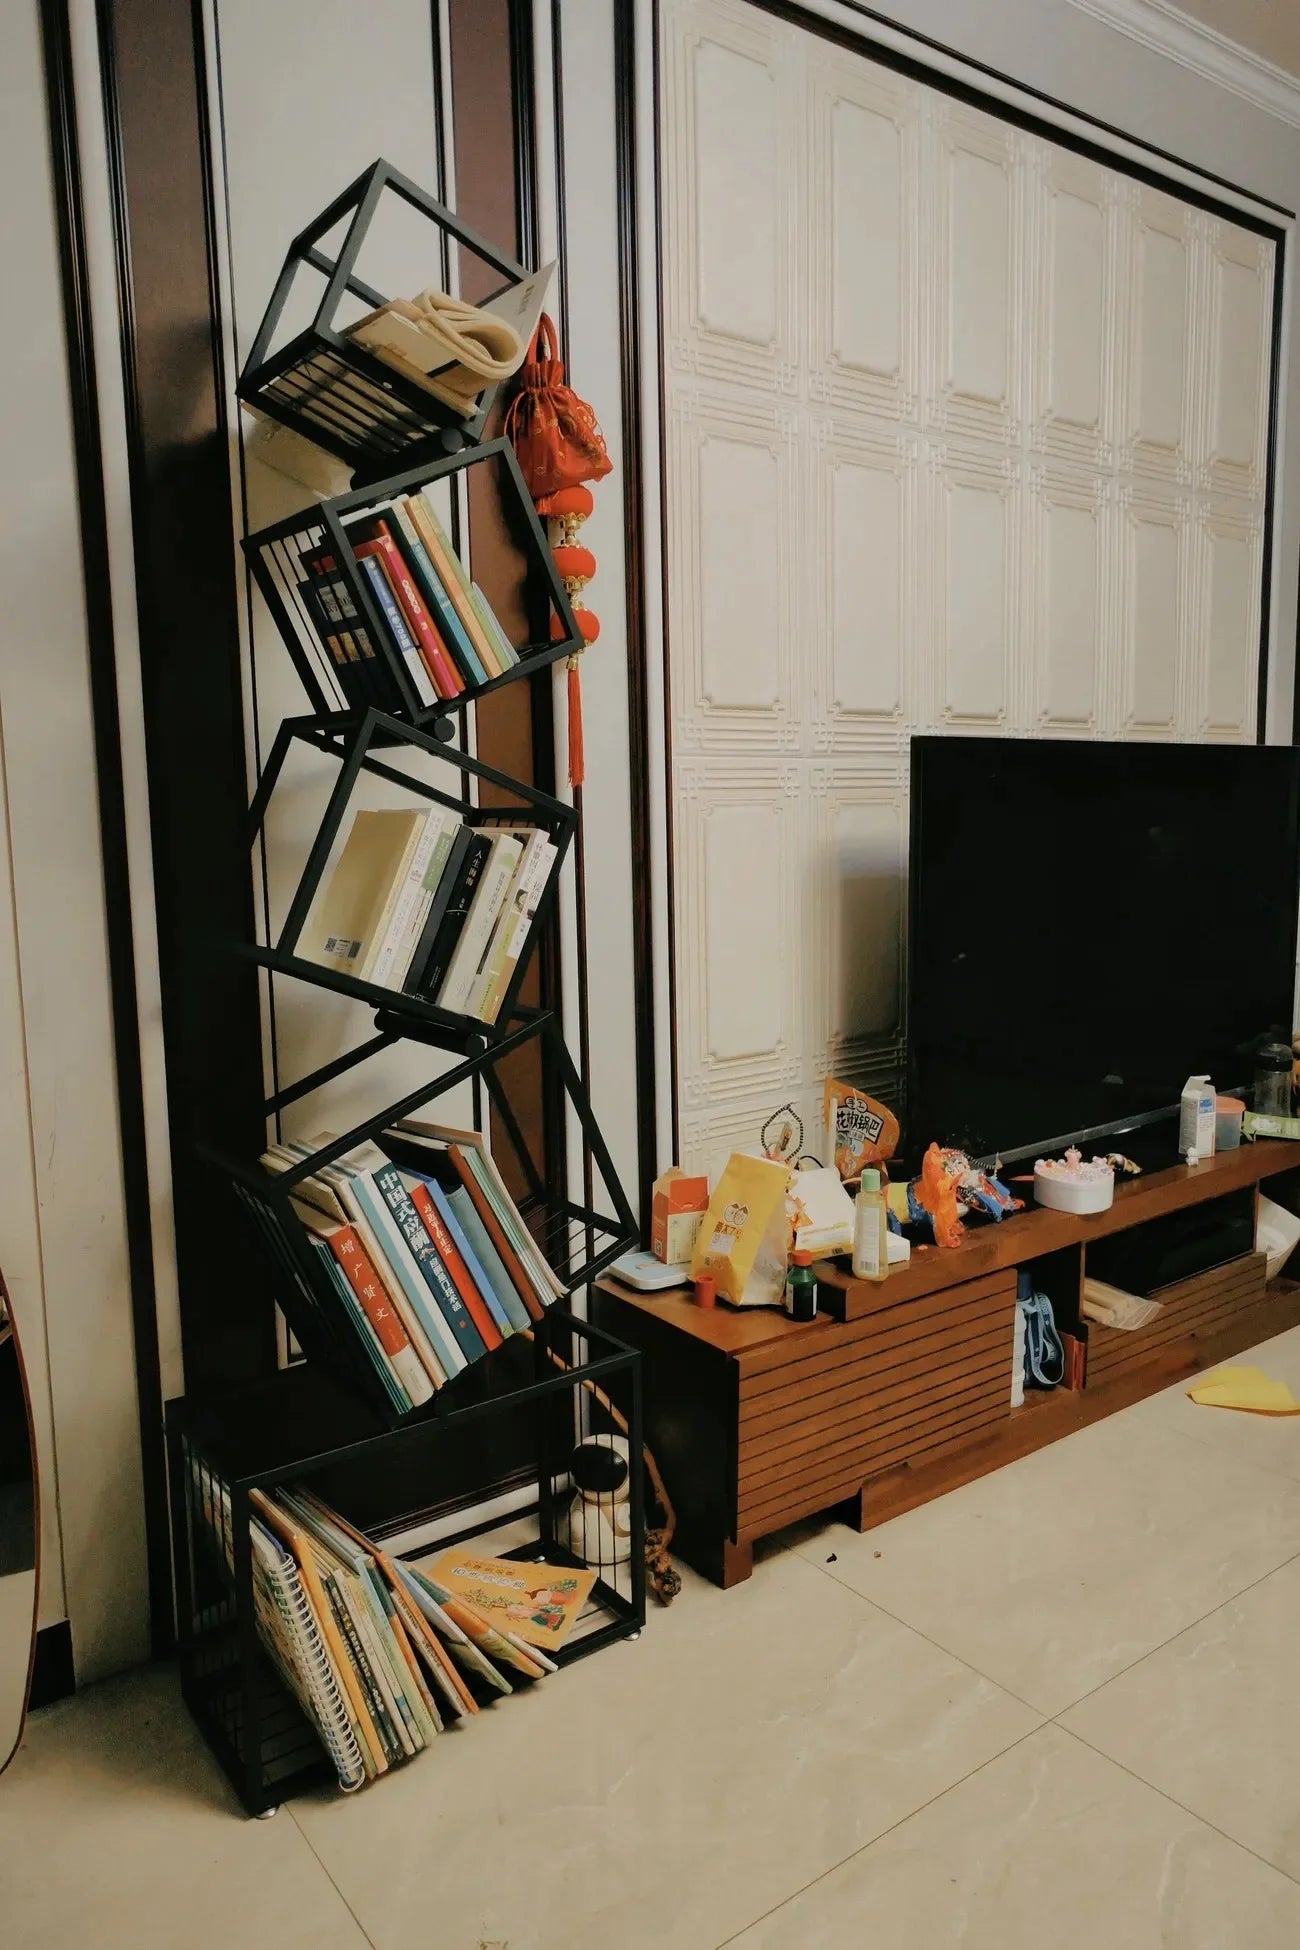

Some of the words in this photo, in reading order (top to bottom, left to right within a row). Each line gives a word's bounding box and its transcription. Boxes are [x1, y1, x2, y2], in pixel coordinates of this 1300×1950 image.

[380, 1172, 431, 1252] 中国式应酬
[340, 1240, 389, 1321] 增广贤文
